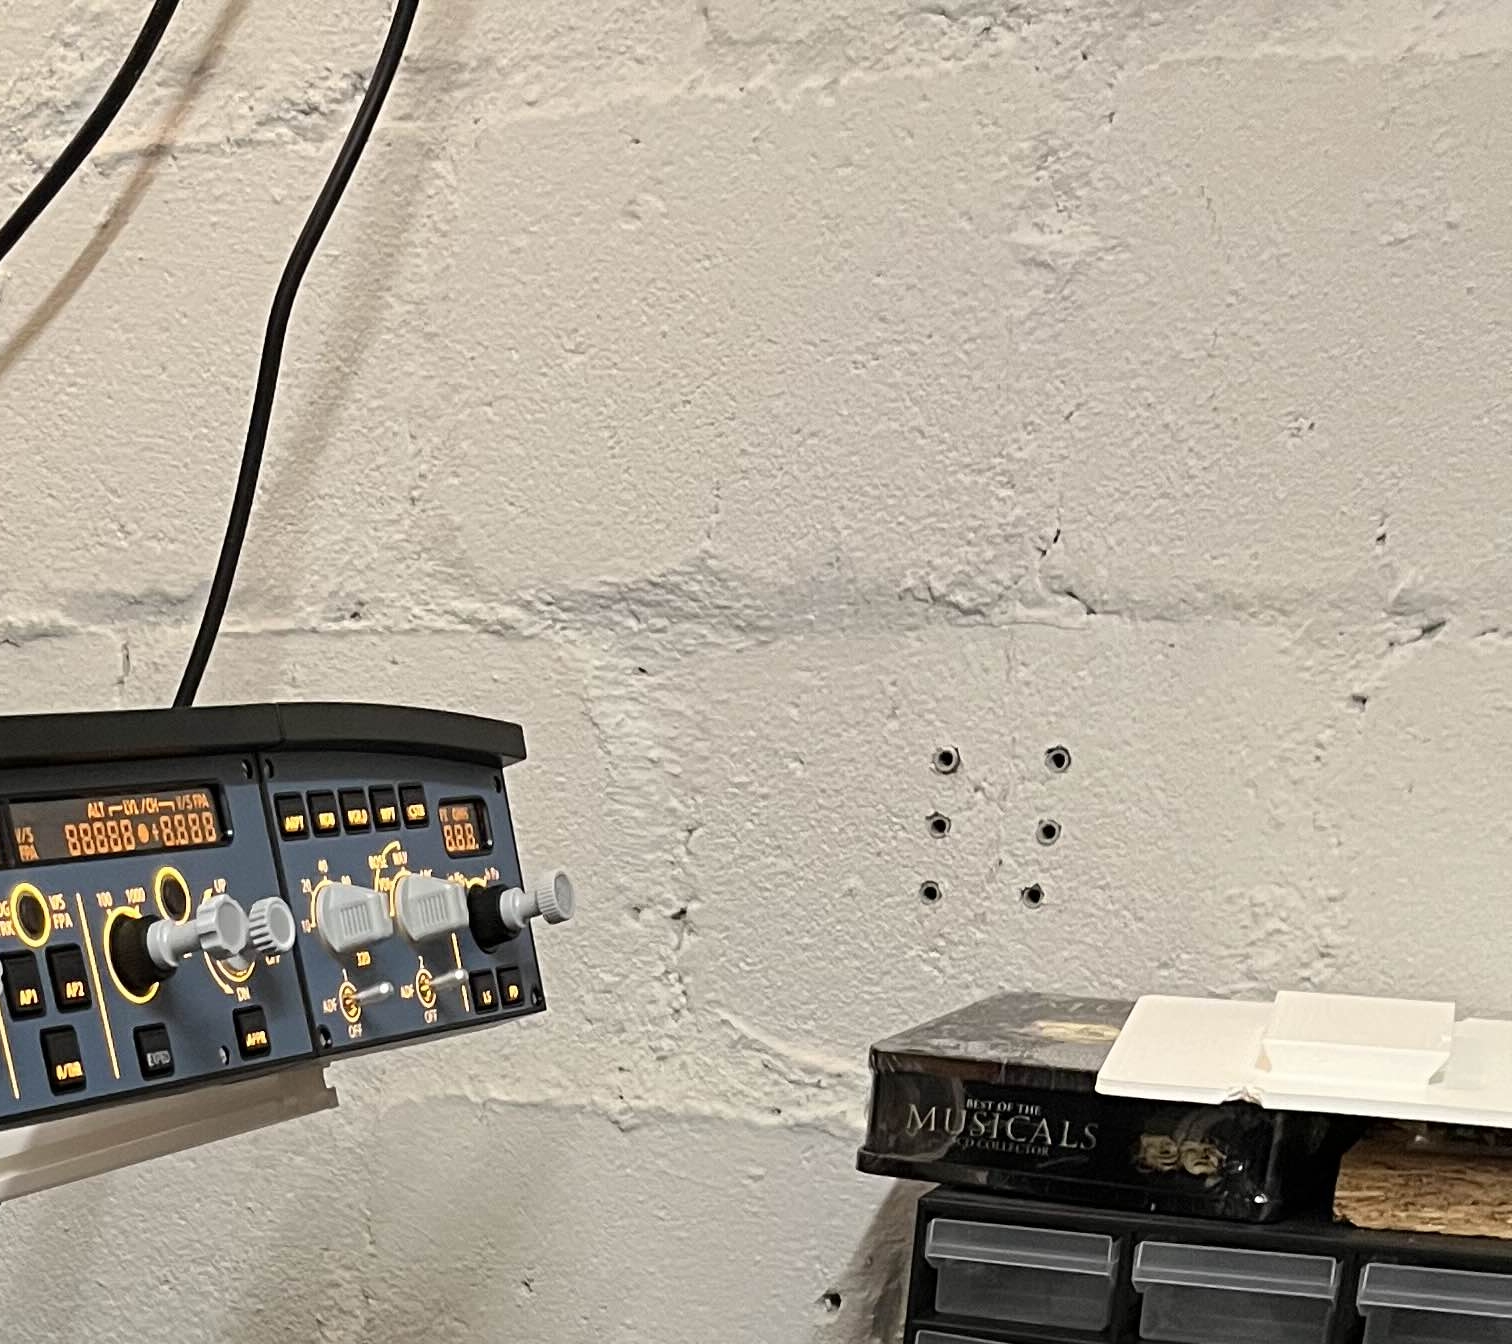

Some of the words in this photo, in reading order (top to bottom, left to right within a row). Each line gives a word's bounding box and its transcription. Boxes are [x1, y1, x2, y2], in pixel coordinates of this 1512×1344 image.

[19, 989, 39, 1006] AP1
[66, 981, 85, 999] AP2
[966, 1098, 992, 1110] BEST
[997, 1101, 1013, 1112] OF
[1018, 1103, 1040, 1116] THE
[906, 1104, 1099, 1149] MUSICALS
